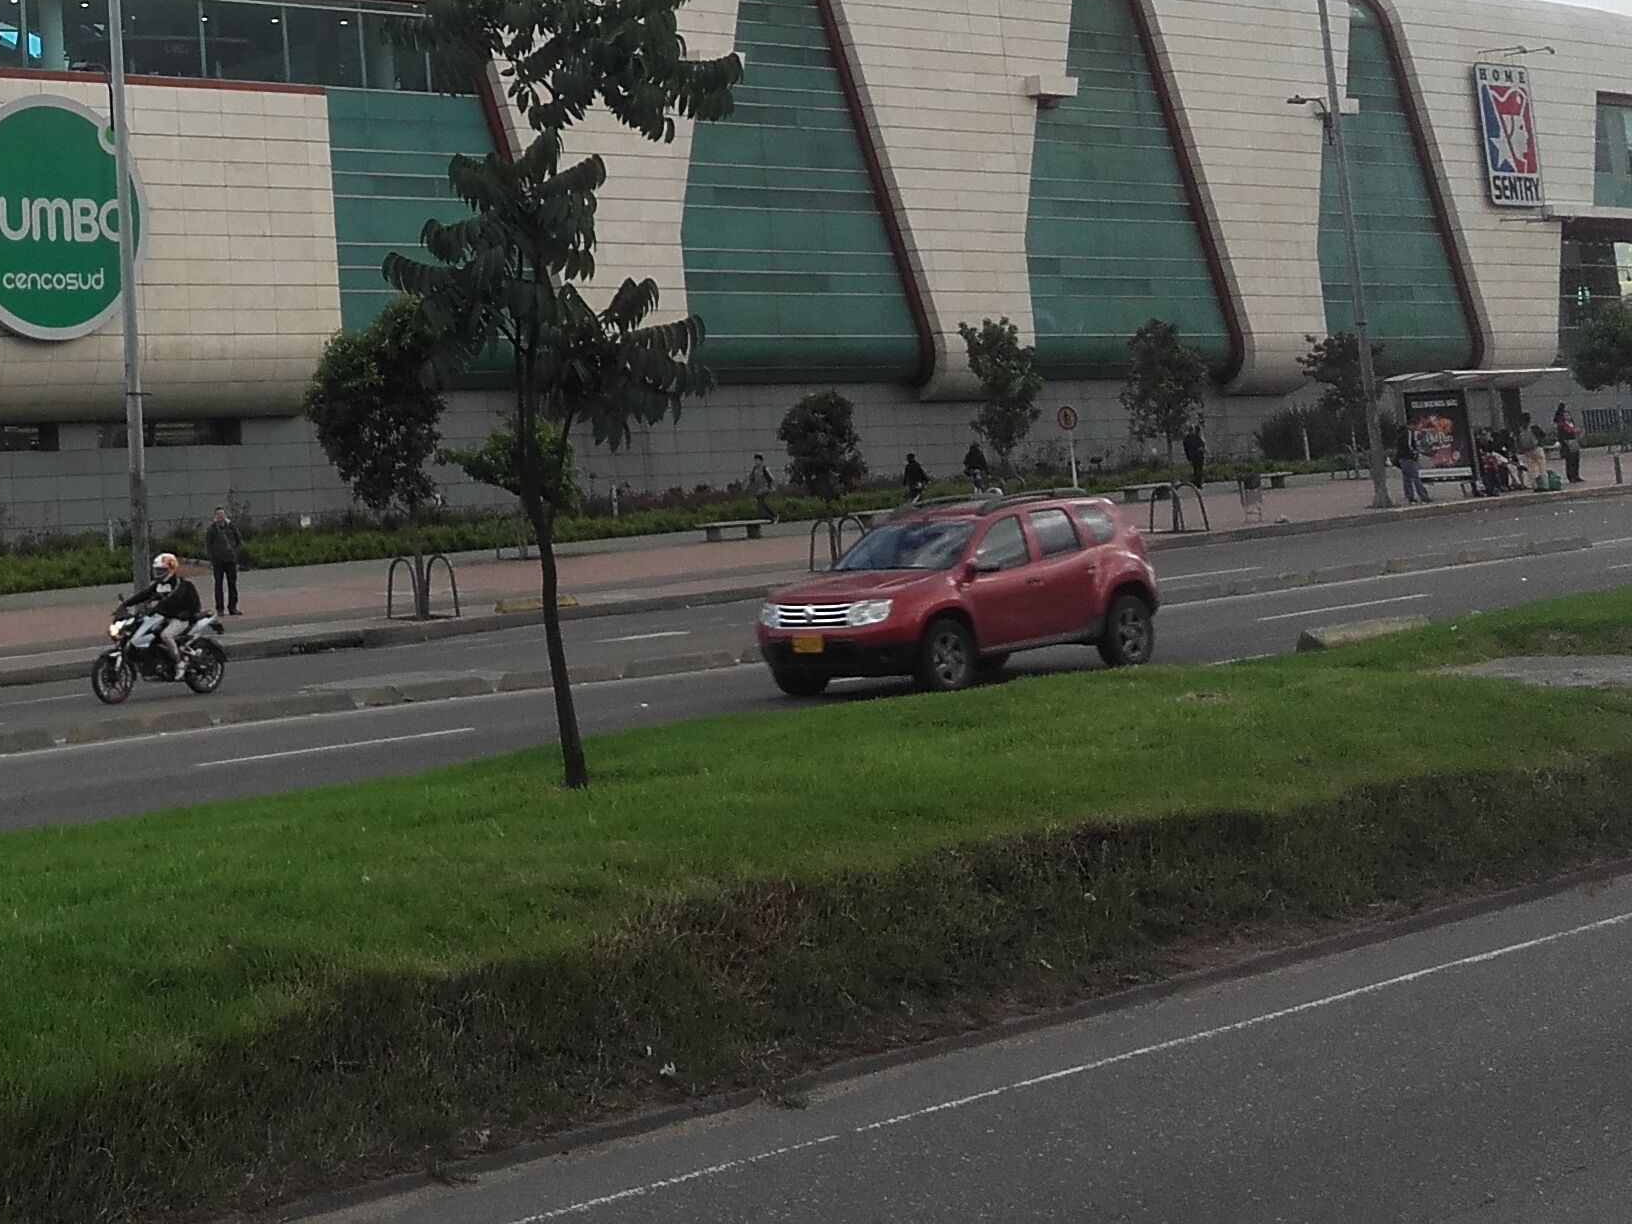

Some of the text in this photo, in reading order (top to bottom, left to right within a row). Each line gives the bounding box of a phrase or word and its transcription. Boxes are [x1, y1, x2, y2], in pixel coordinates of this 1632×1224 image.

[1478, 67, 1527, 84] HOME
[1491, 174, 1541, 202] SENTRY
[2, 267, 105, 291] cencosud
